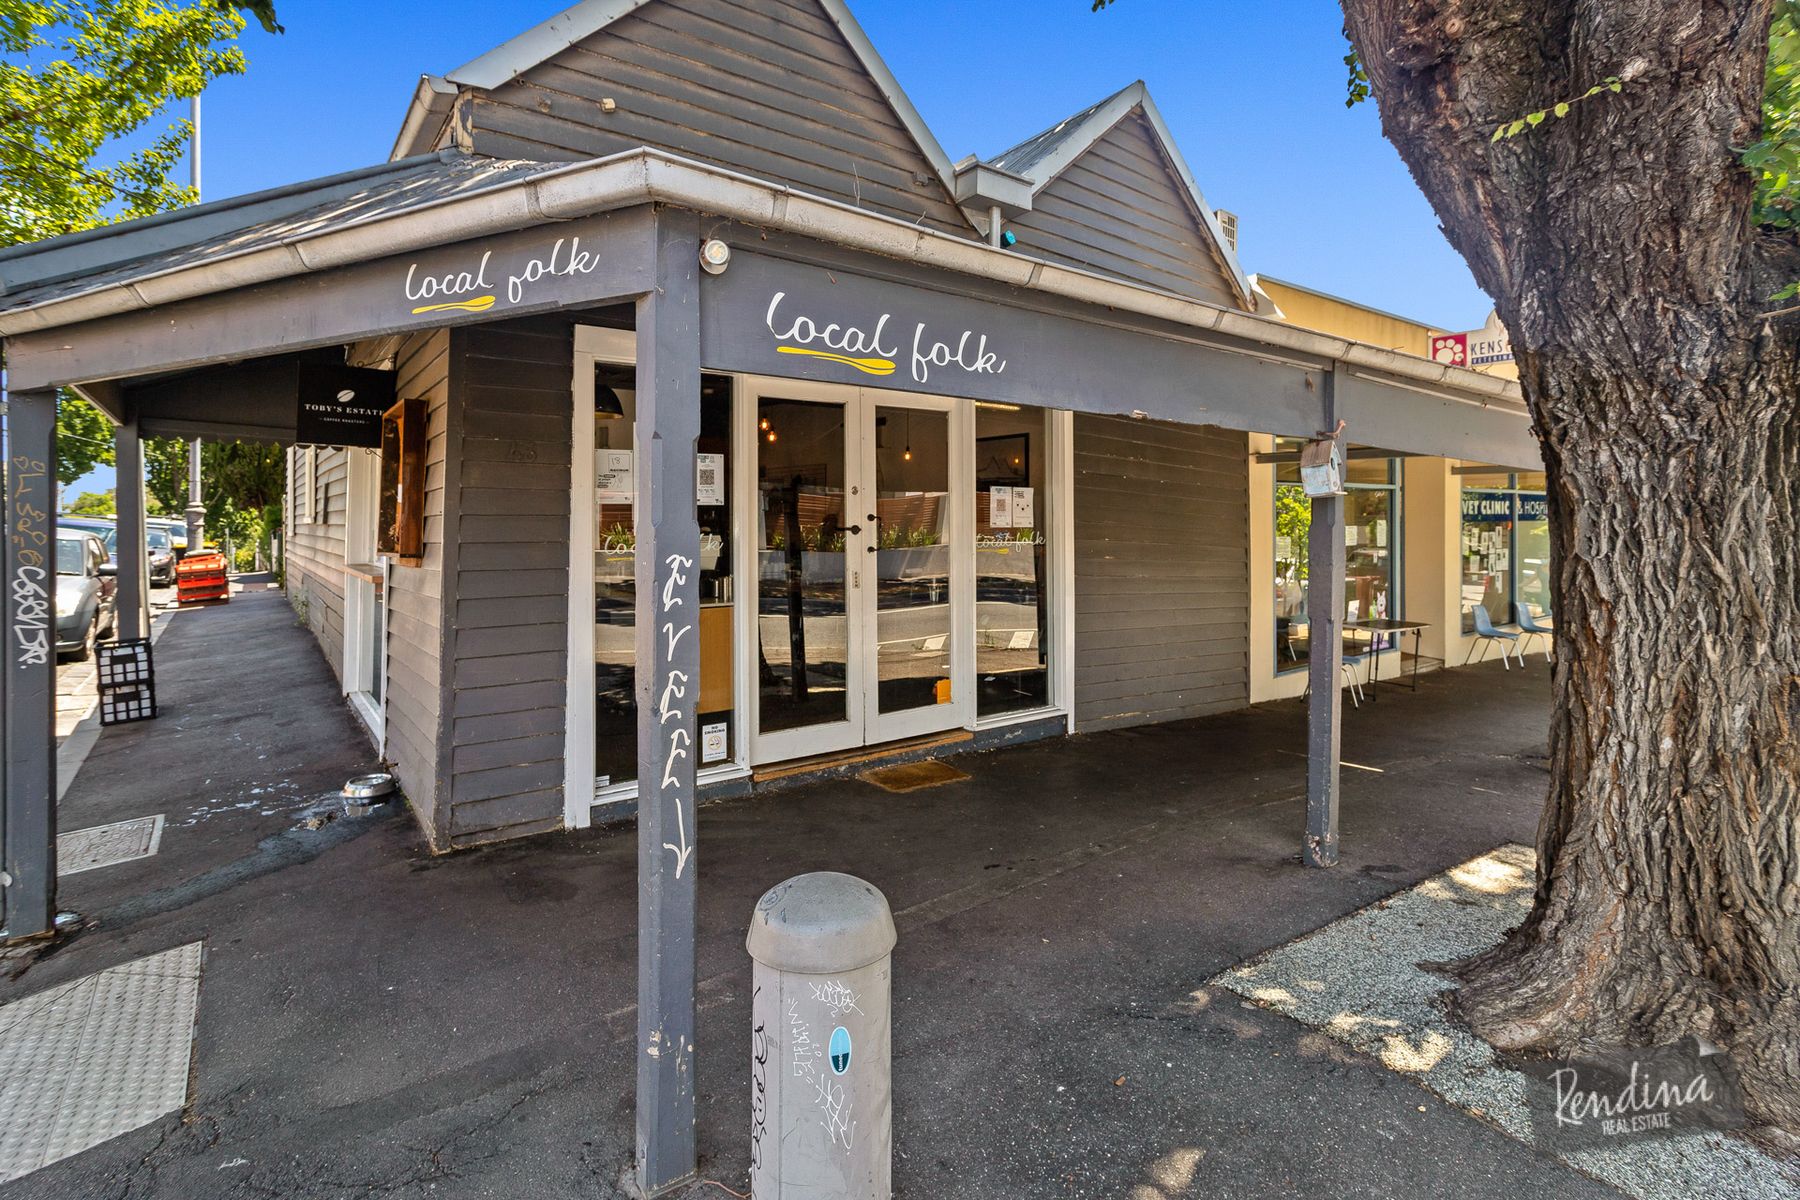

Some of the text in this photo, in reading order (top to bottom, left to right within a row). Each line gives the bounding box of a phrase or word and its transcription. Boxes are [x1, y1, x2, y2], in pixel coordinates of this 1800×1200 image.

[507, 236, 600, 304] folk
[912, 322, 1007, 384] folk
[304, 403, 342, 413] TOBY'S
[1462, 500, 1480, 515] VET
[1480, 500, 1511, 516] CLINIC
